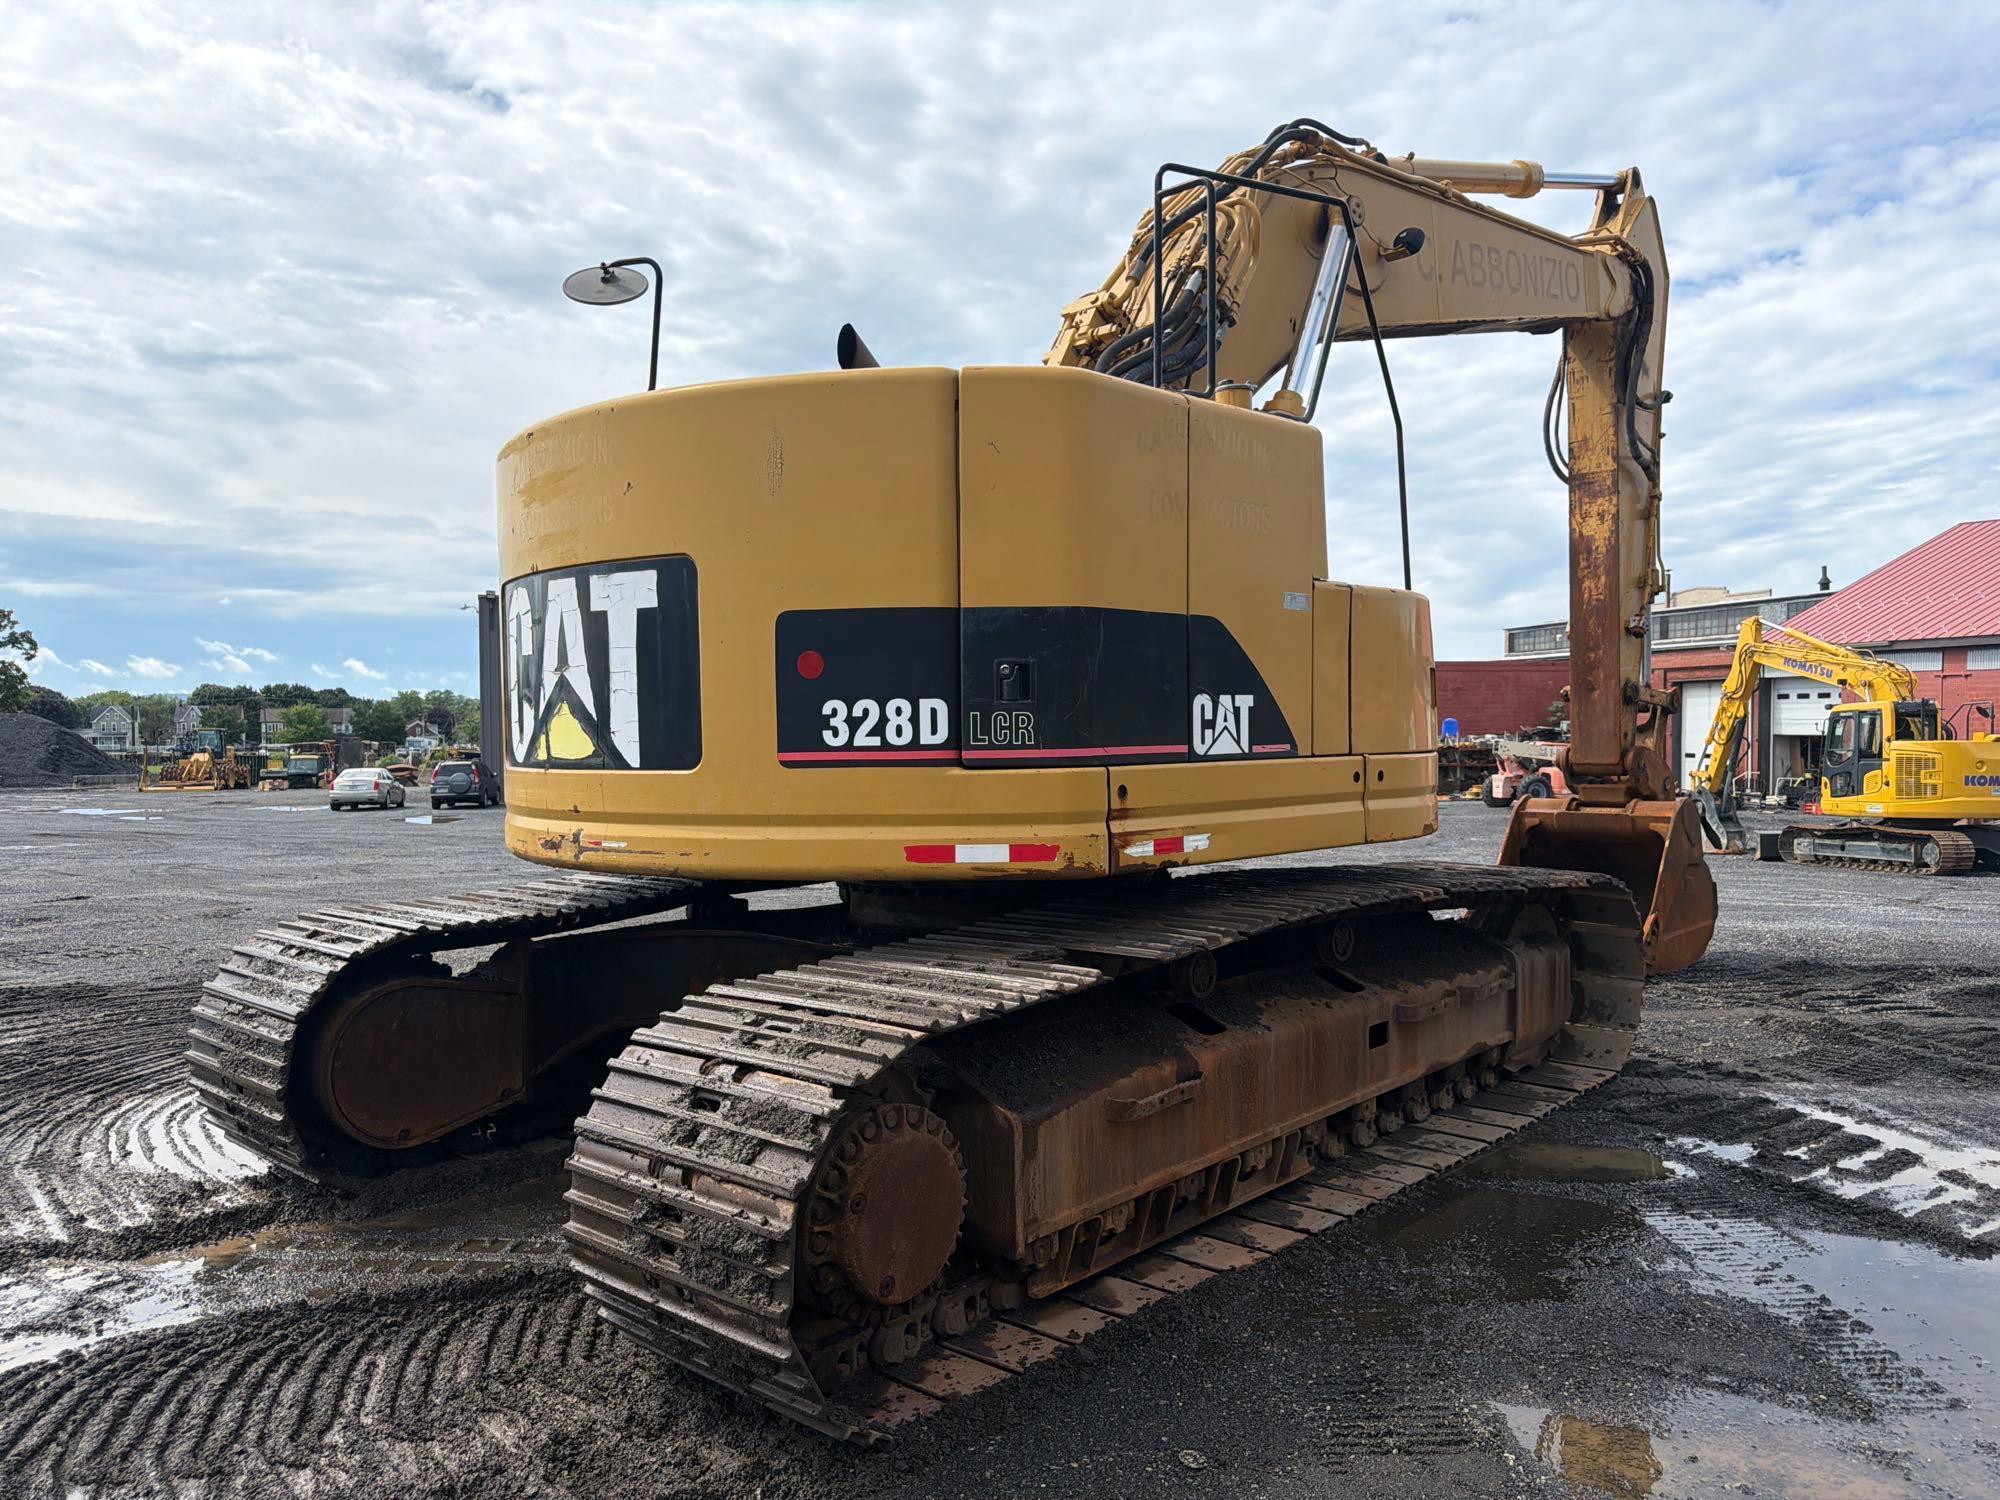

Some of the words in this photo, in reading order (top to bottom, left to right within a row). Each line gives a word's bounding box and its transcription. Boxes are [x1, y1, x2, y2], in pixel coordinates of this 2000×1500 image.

[1451, 239, 1580, 303] ABBONIZIO
[1146, 488, 1272, 535] CONRACTORS
[509, 570, 658, 768] CAT
[1783, 656, 1834, 679] KOMATSU
[821, 698, 948, 747] 328D
[970, 711, 1034, 745] LCR
[1193, 693, 1254, 755] CAT
